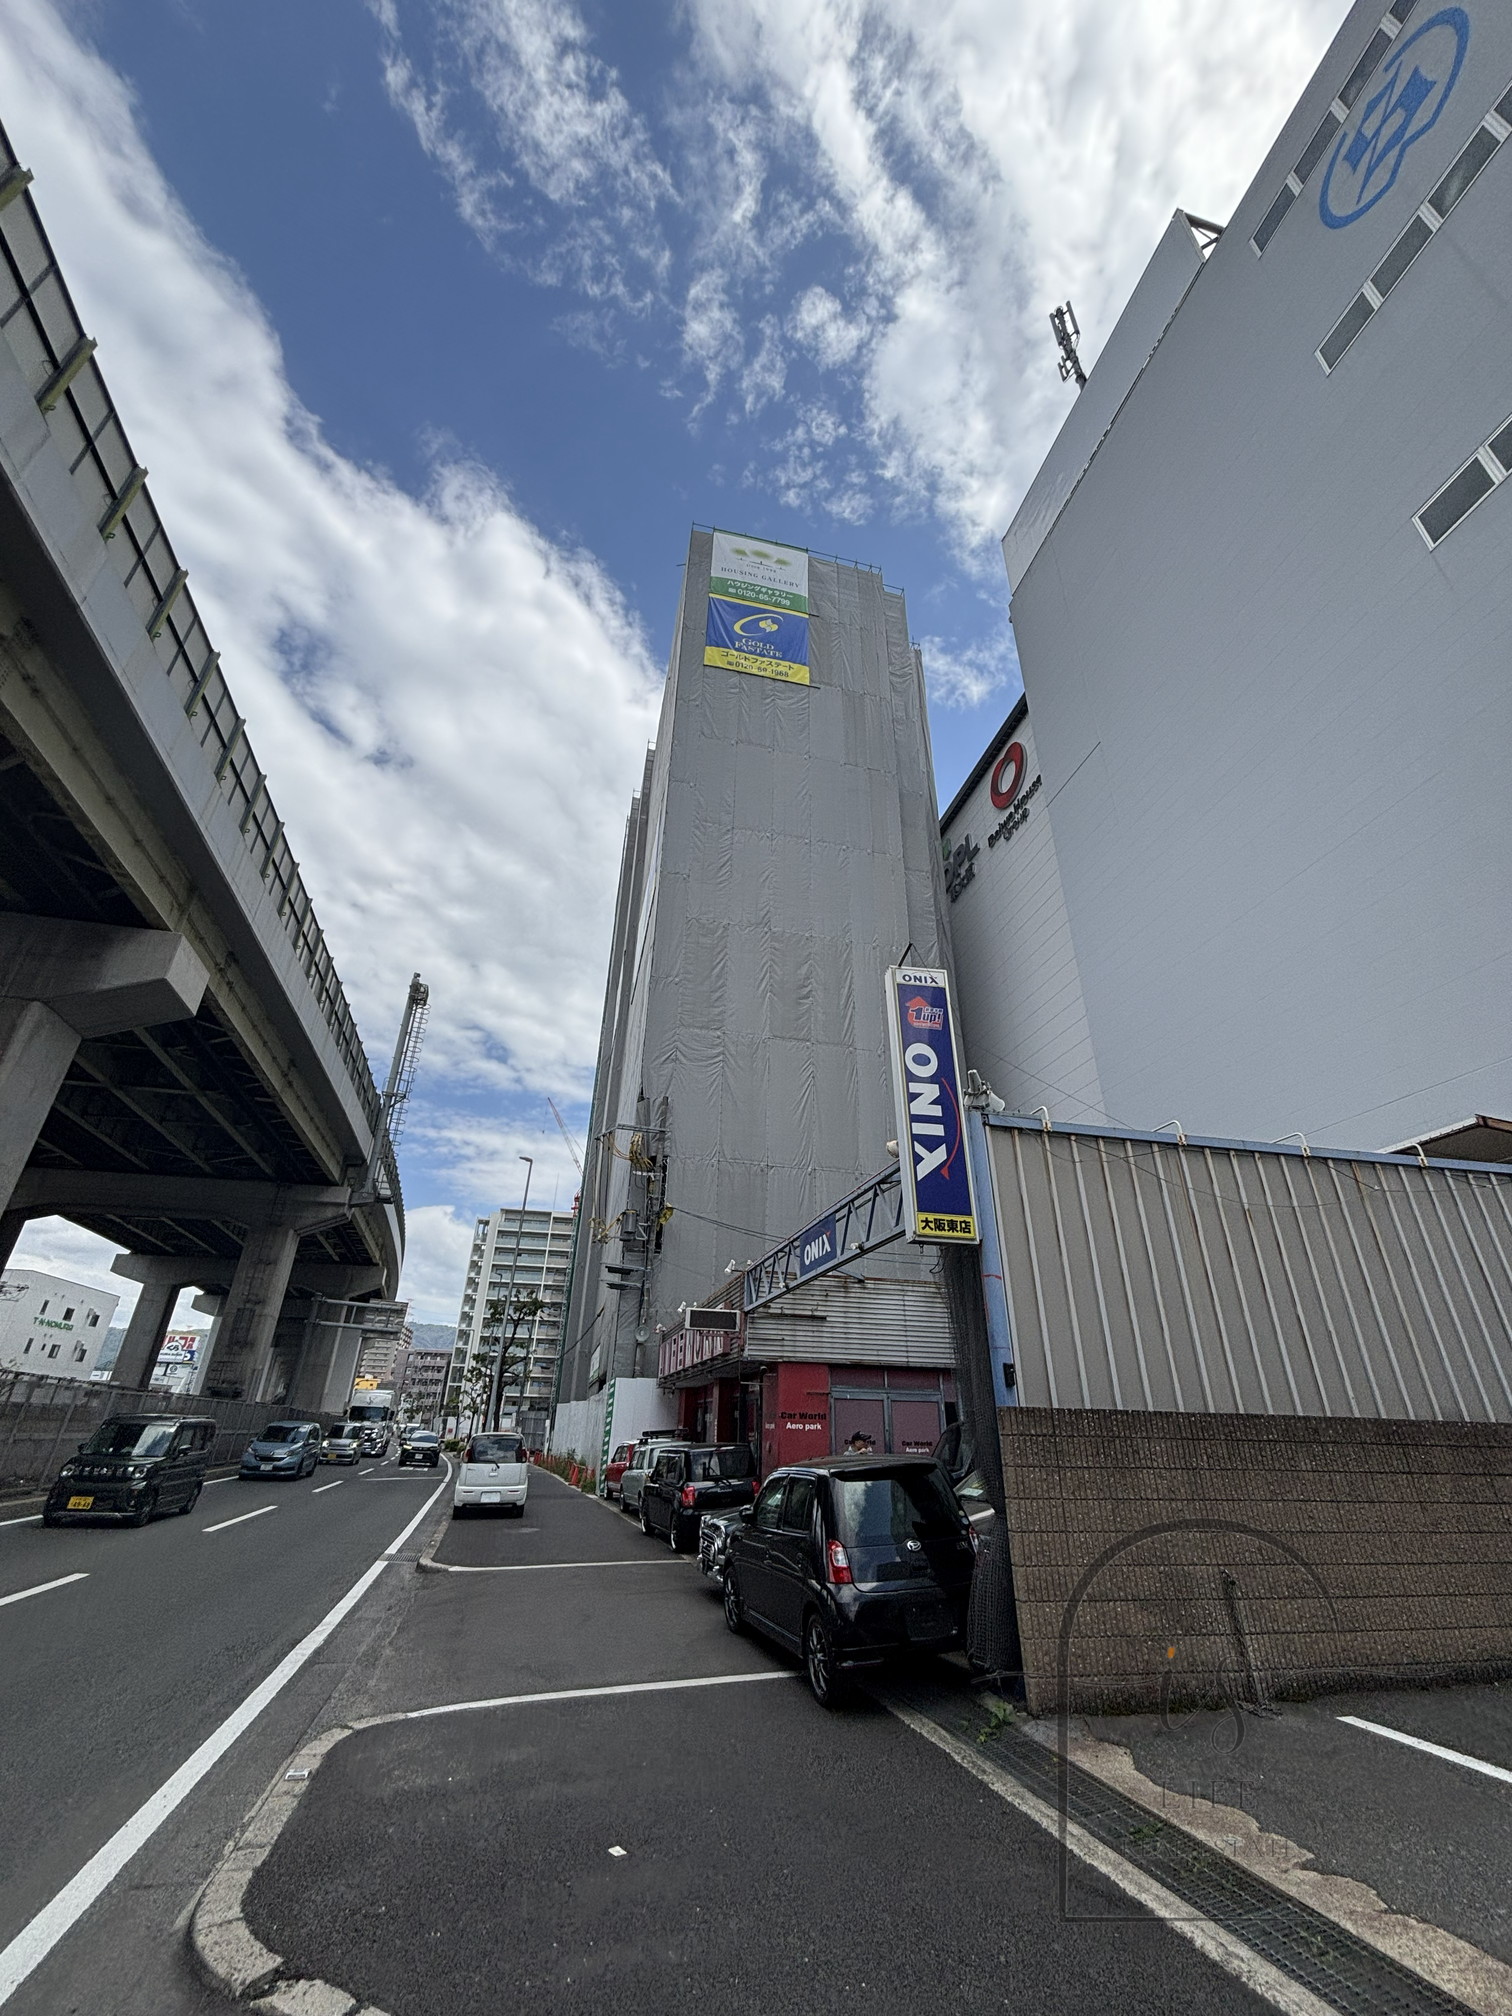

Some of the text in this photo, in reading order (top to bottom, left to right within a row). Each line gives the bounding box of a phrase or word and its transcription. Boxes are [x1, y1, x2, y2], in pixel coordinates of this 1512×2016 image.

[720, 567, 800, 588] HOUSING GALLERY
[726, 580, 794, 598] ハウジングギャラリー
[734, 641, 783, 658] FASTATE
[742, 637, 775, 650] GOLD
[721, 650, 795, 670] ゴールドファステート
[1014, 774, 1043, 815] House
[902, 973, 939, 985] ONIX
[905, 1042, 947, 1181] ONIX
[920, 1216, 972, 1235] 大阪東店
[803, 1231, 832, 1266] ONIX
[780, 1411, 827, 1420] Car World
[785, 1421, 804, 1430] Aero
[805, 1422, 822, 1431] park
